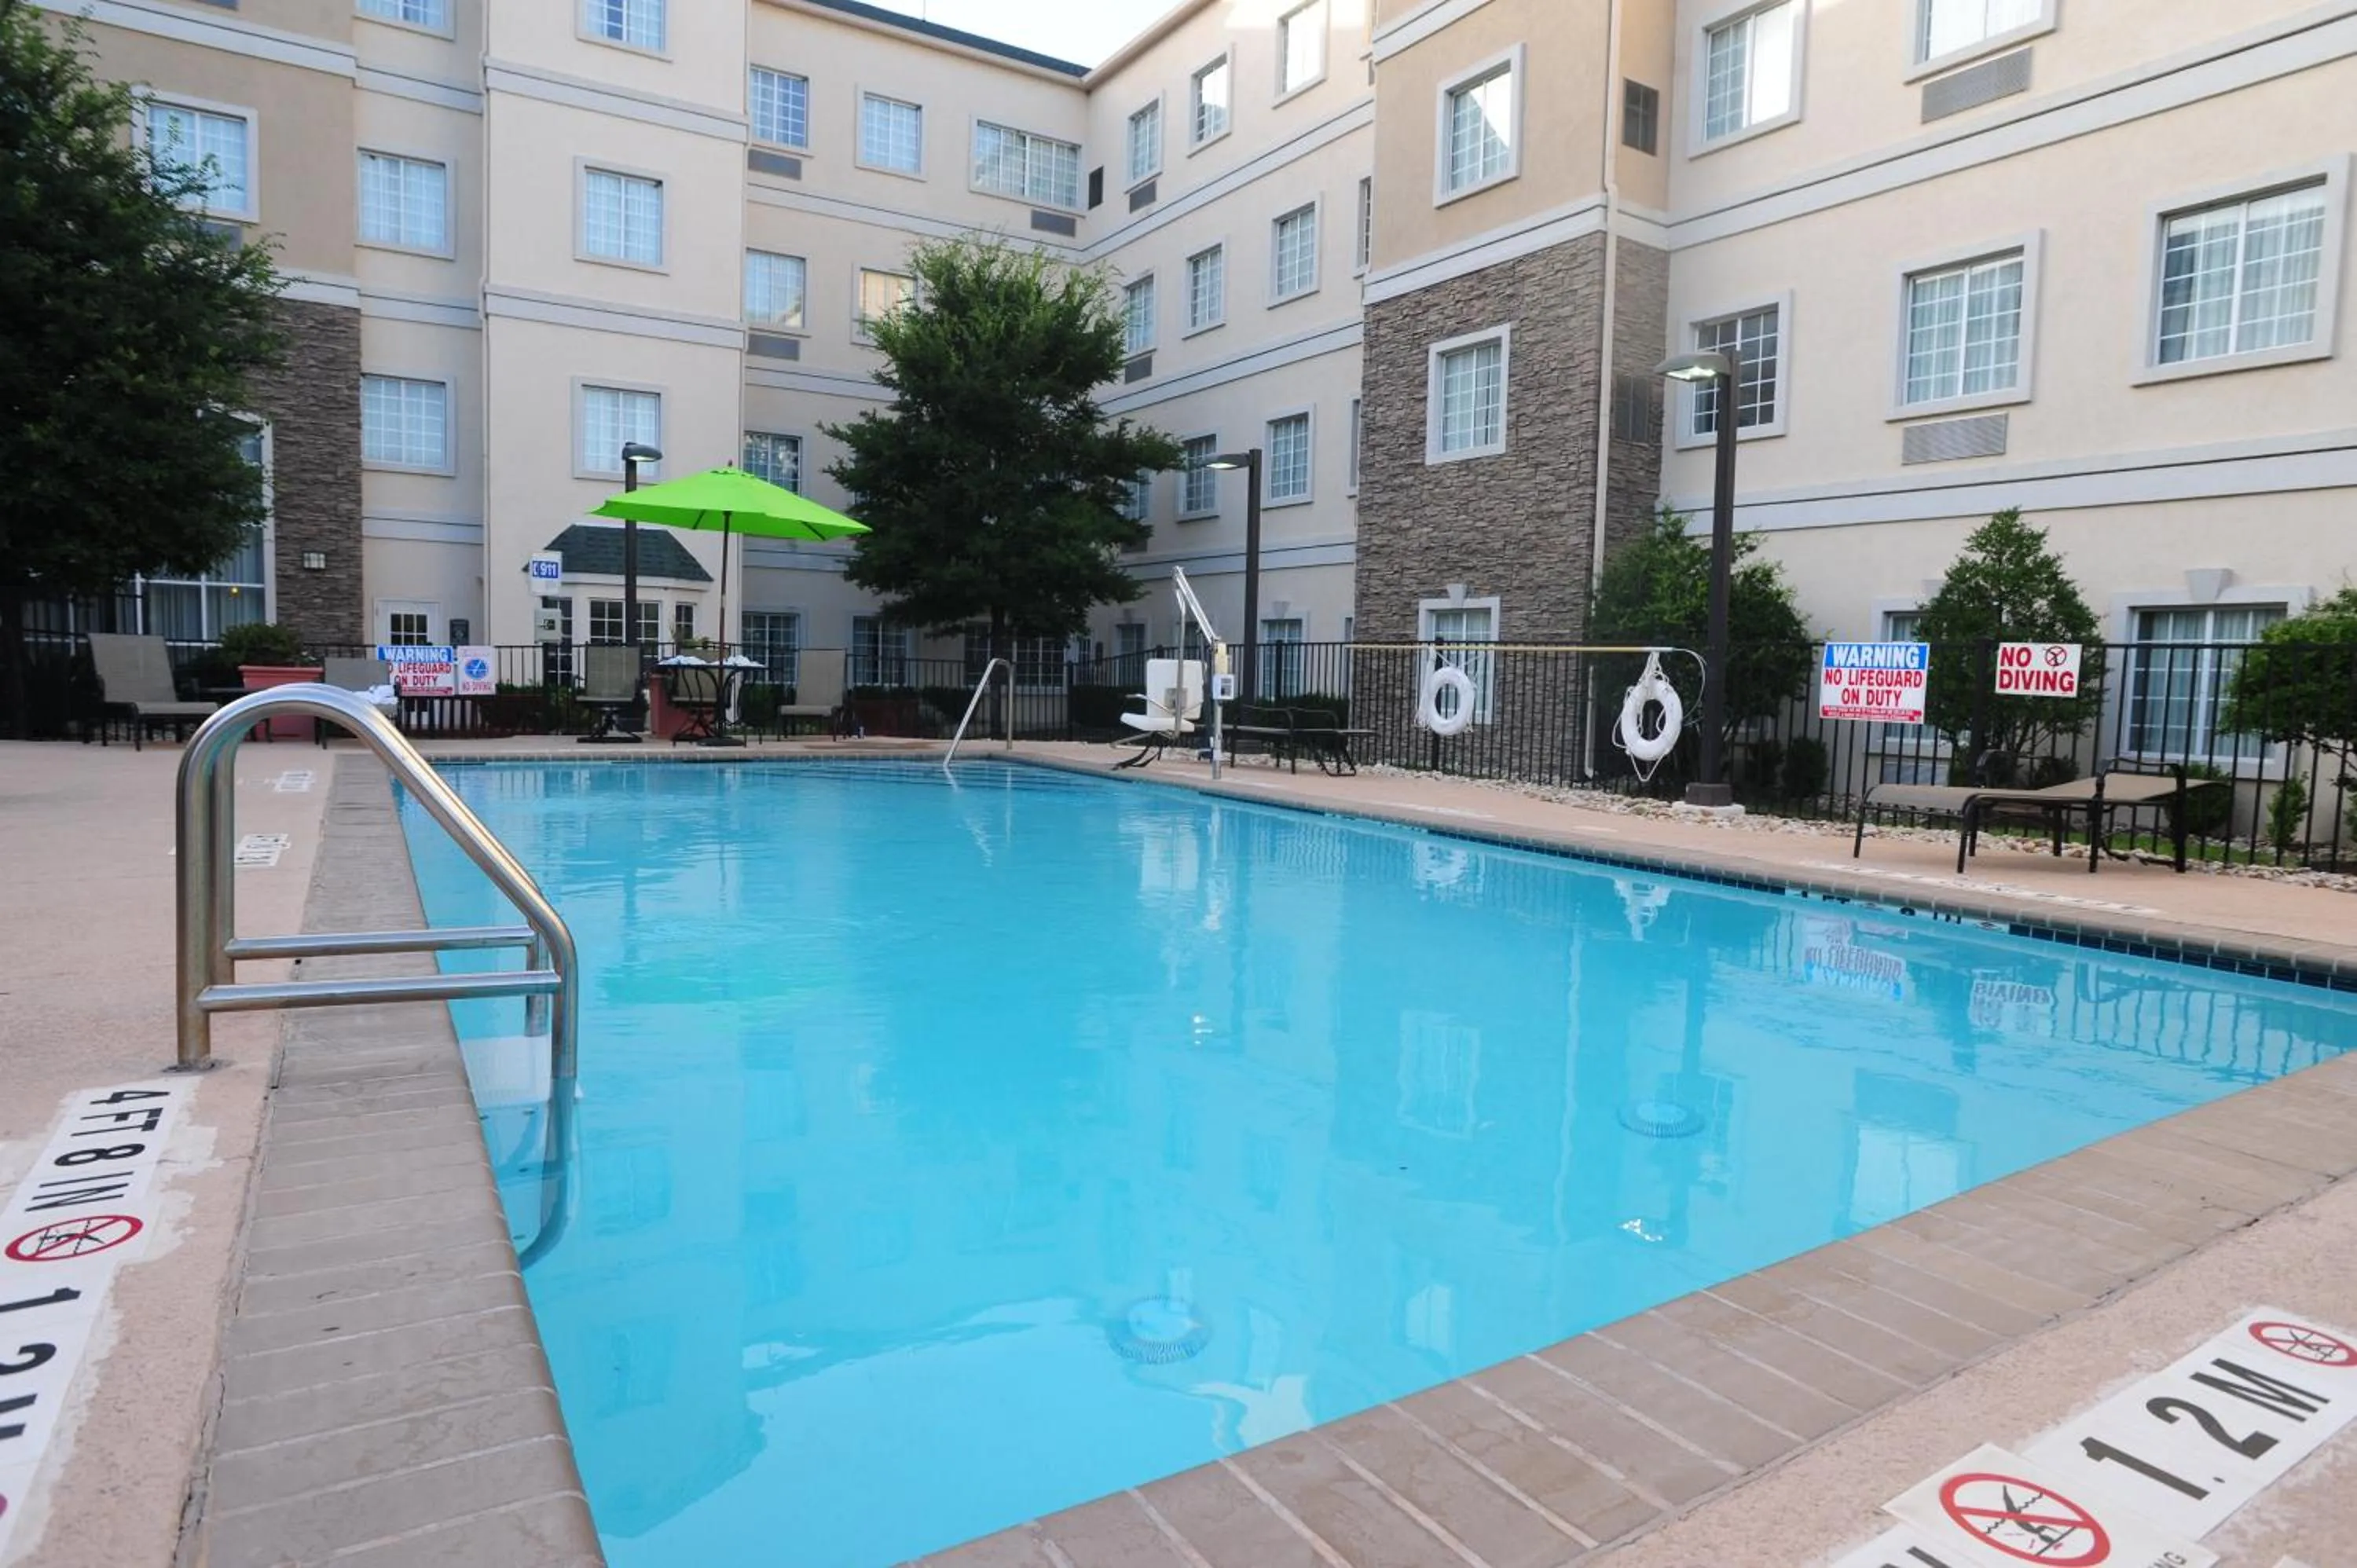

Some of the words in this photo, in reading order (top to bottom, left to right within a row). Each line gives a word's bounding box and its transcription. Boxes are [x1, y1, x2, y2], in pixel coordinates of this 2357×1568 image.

[540, 562, 556, 577] 911
[383, 648, 448, 661] WARNING
[1833, 645, 1919, 668] WARNING
[2000, 647, 2032, 667] NO
[398, 662, 452, 674] LIFEGUARD
[394, 675, 408, 686] ON
[412, 676, 438, 686] DUTY
[1824, 669, 1842, 685] NO
[1848, 670, 1923, 687] LIFEGUARD
[1999, 669, 2074, 692] DIVING
[1842, 688, 1860, 705] ON
[1866, 690, 1901, 706] DUTY
